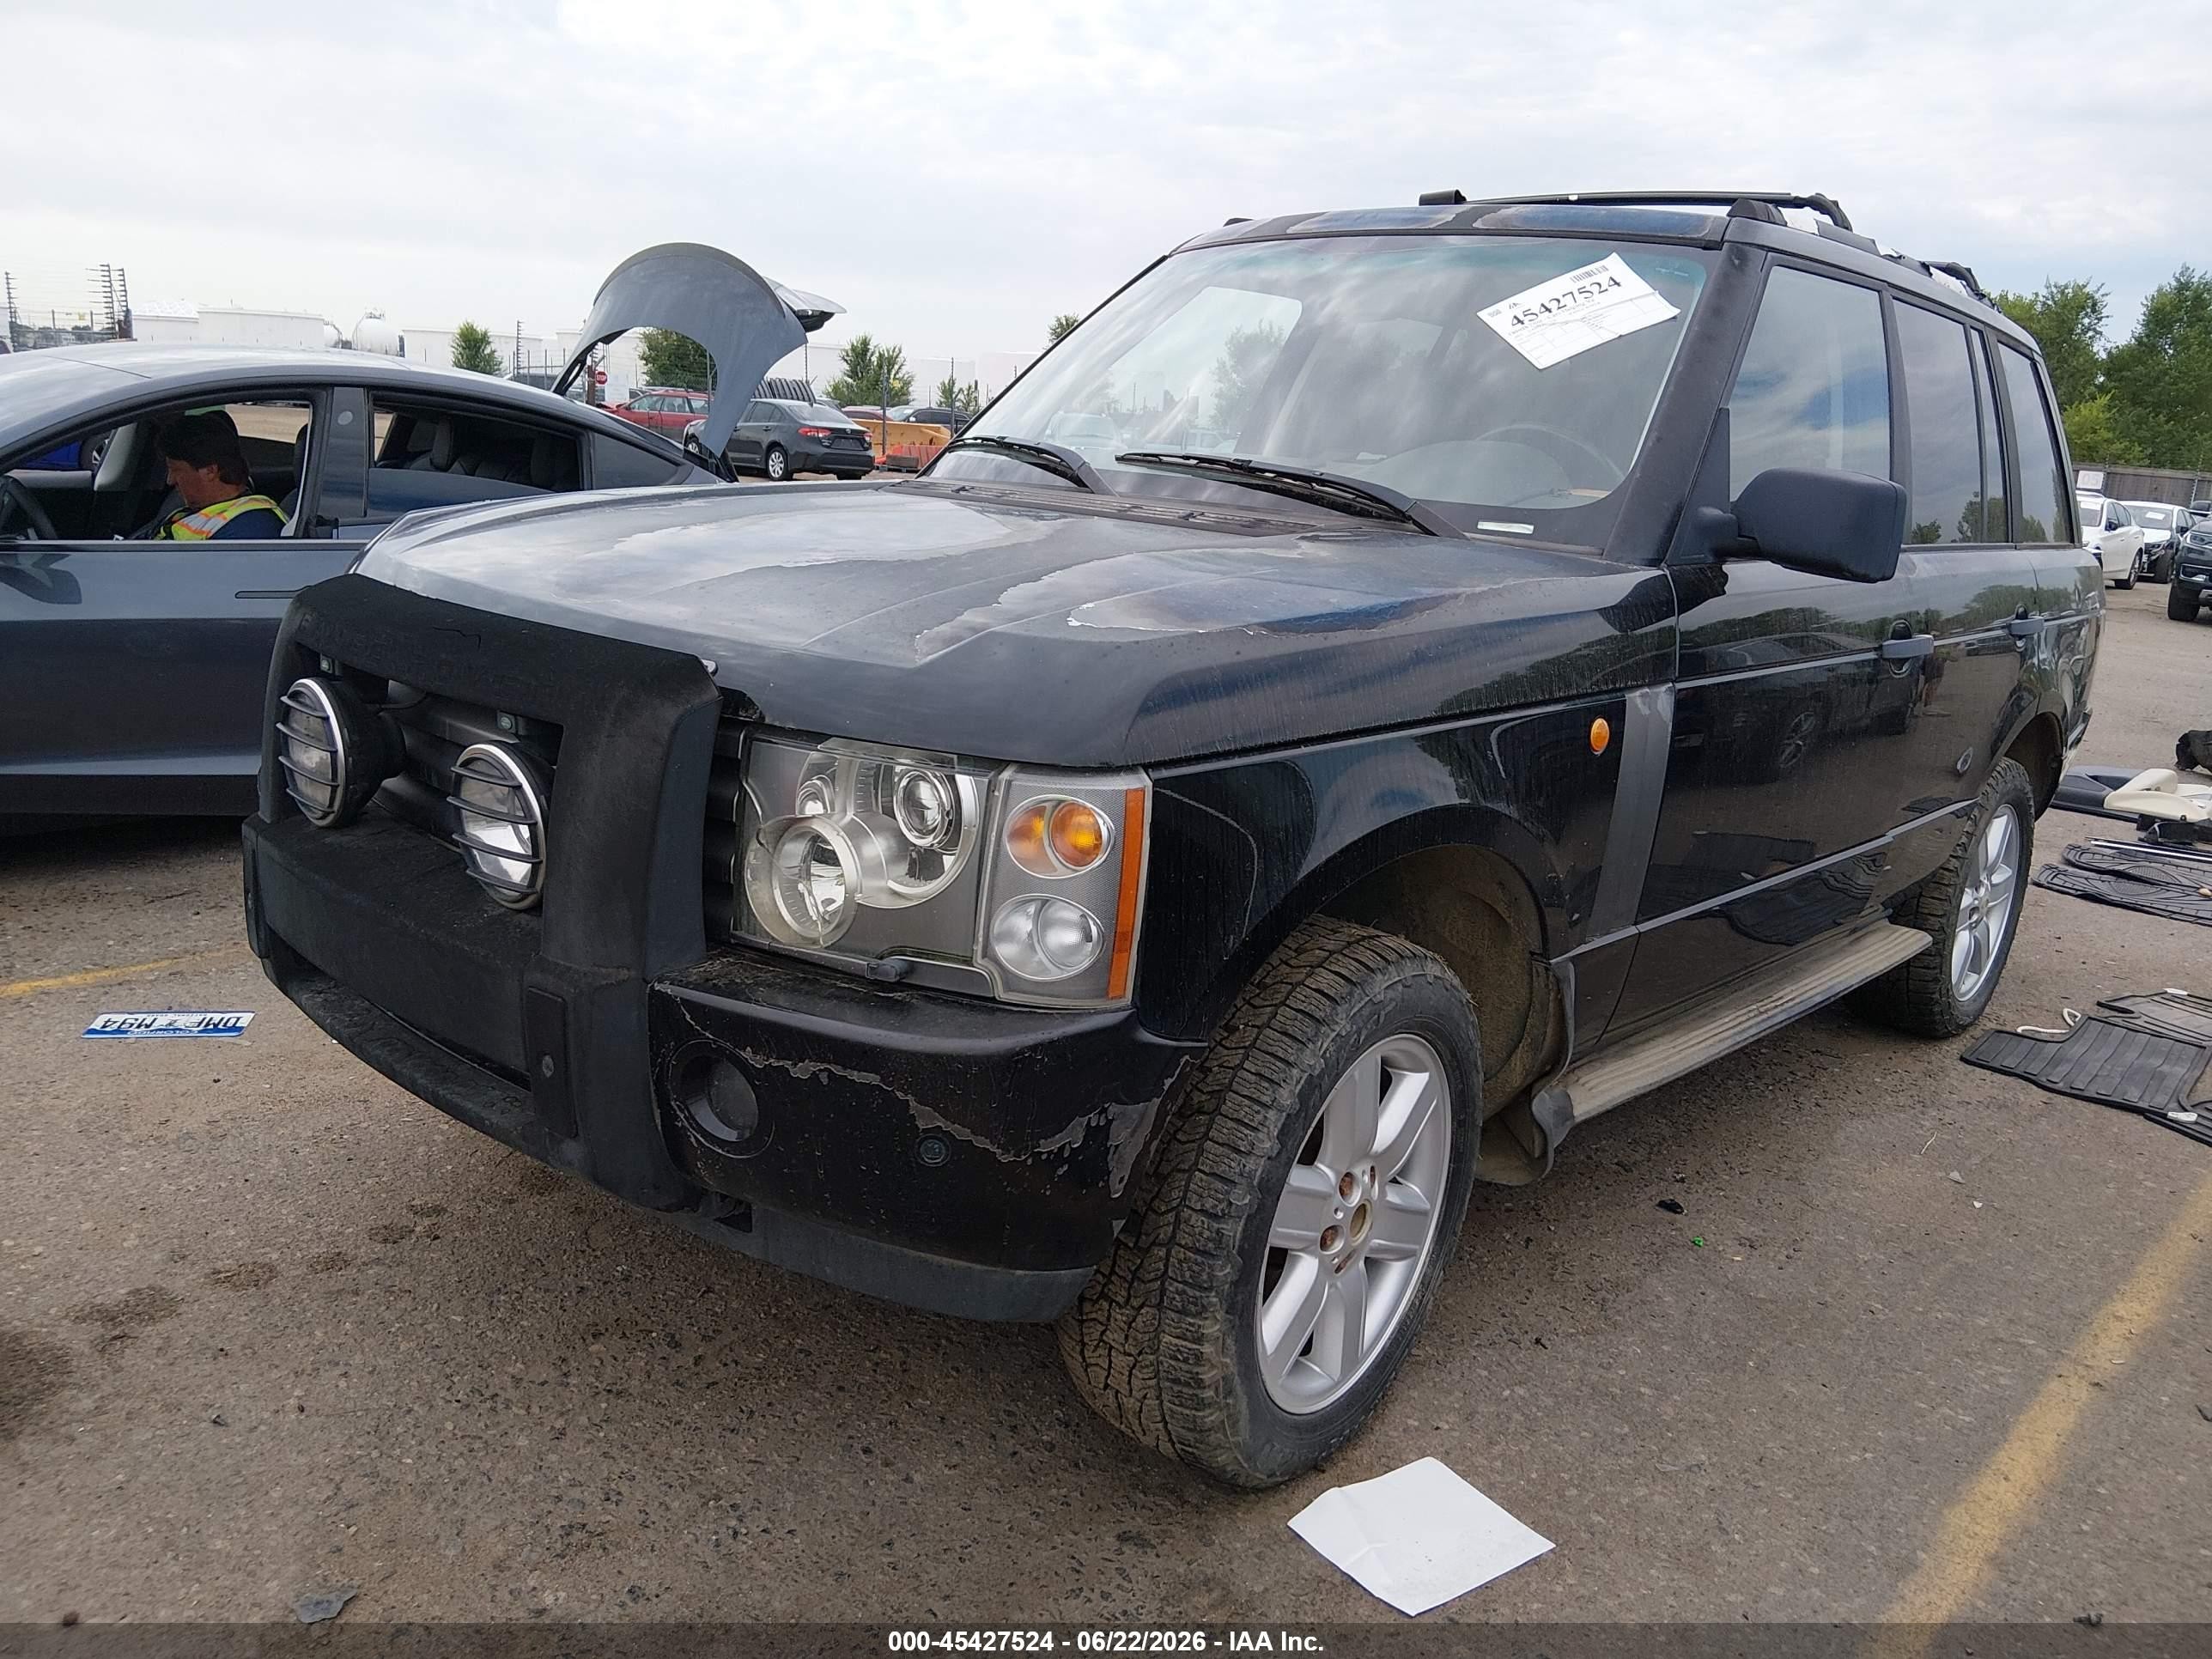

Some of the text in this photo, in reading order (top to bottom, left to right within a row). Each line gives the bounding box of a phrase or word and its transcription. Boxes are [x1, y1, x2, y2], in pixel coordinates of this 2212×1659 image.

[1511, 276, 1621, 326] 45427524
[100, 1016, 244, 1029] DMF M94
